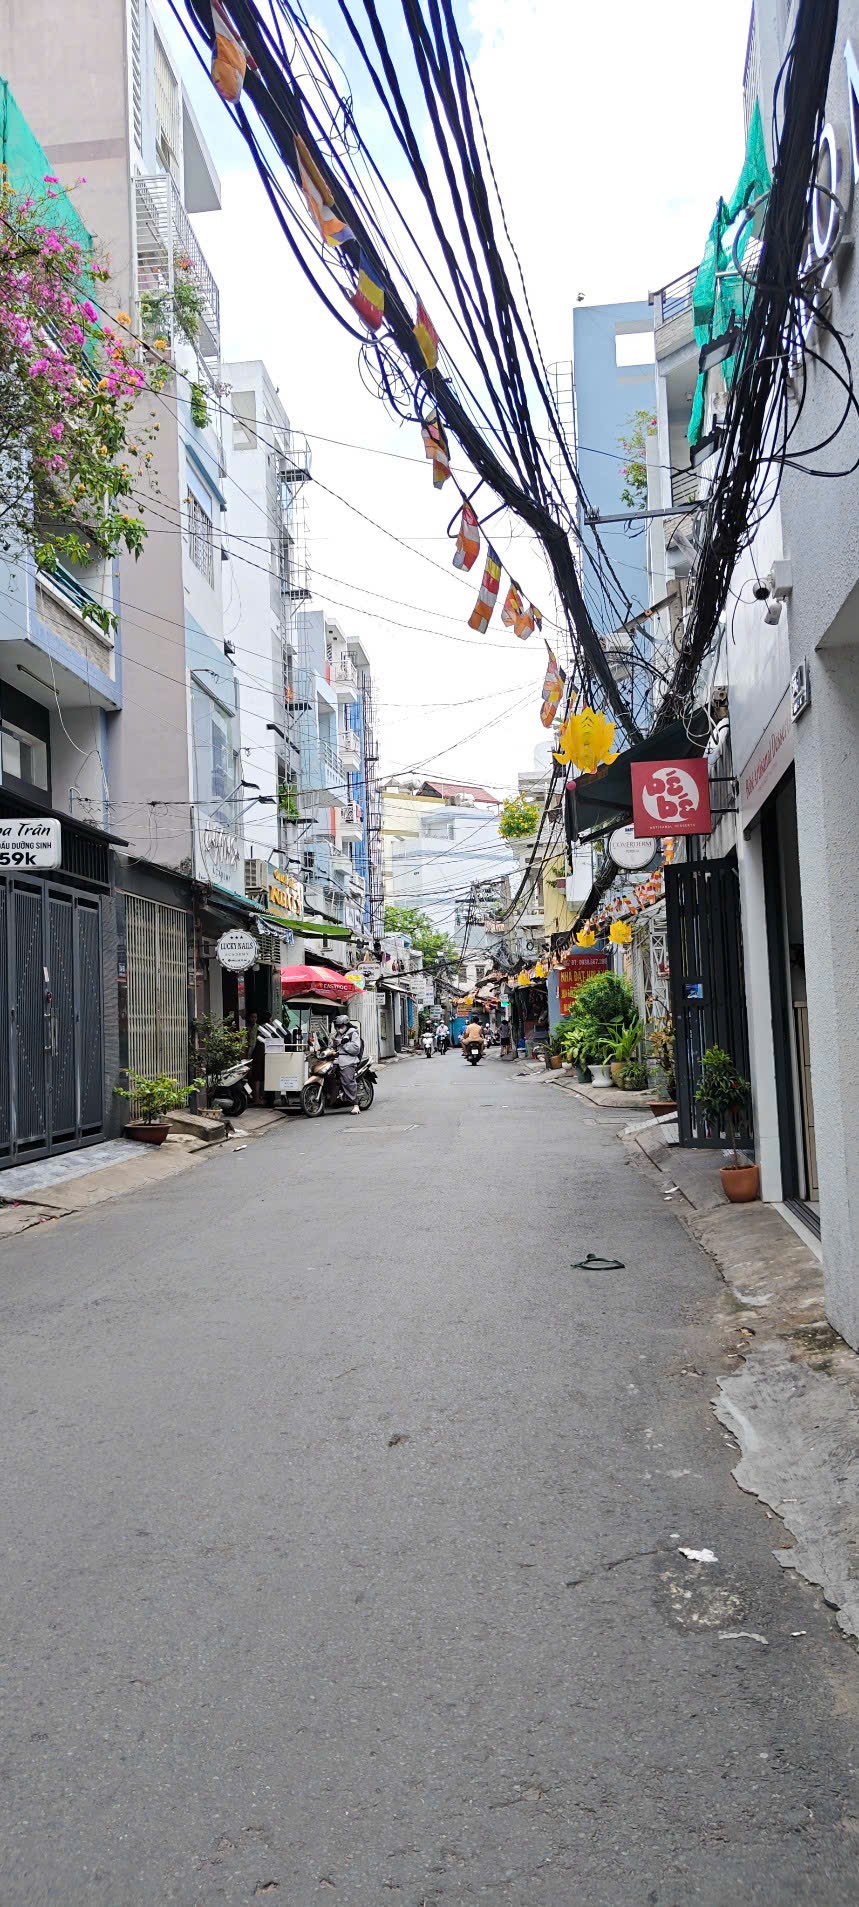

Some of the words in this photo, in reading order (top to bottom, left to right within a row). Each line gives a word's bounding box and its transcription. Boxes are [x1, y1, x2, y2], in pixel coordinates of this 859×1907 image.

[17, 822, 51, 836] Trân
[220, 942, 237, 950] LUCKY
[238, 942, 254, 950] NAILS
